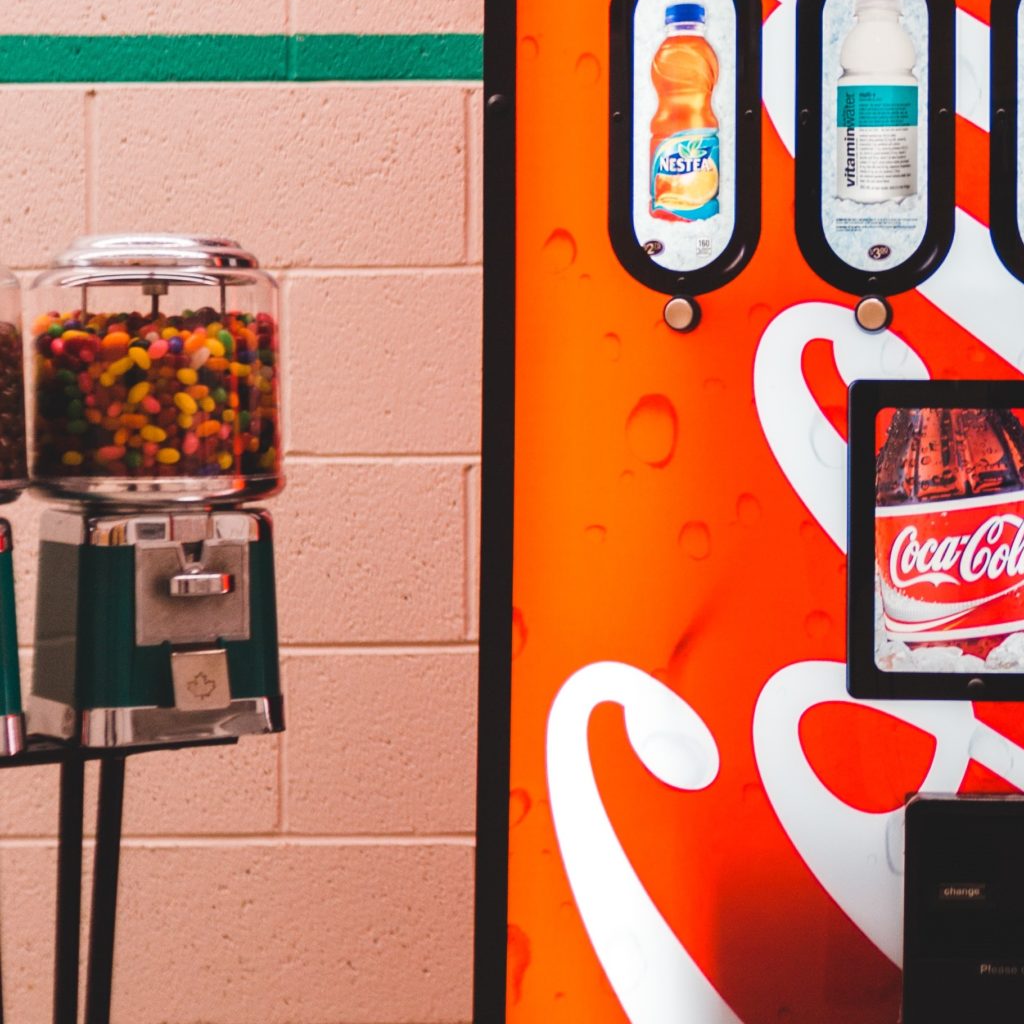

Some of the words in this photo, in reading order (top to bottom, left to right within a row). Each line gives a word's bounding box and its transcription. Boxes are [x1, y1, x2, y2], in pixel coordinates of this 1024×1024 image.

[844, 92, 856, 188] vitaminwater
[659, 157, 711, 173] NESTEA
[943, 886, 980, 897] change
[980, 963, 1018, 975] Please
